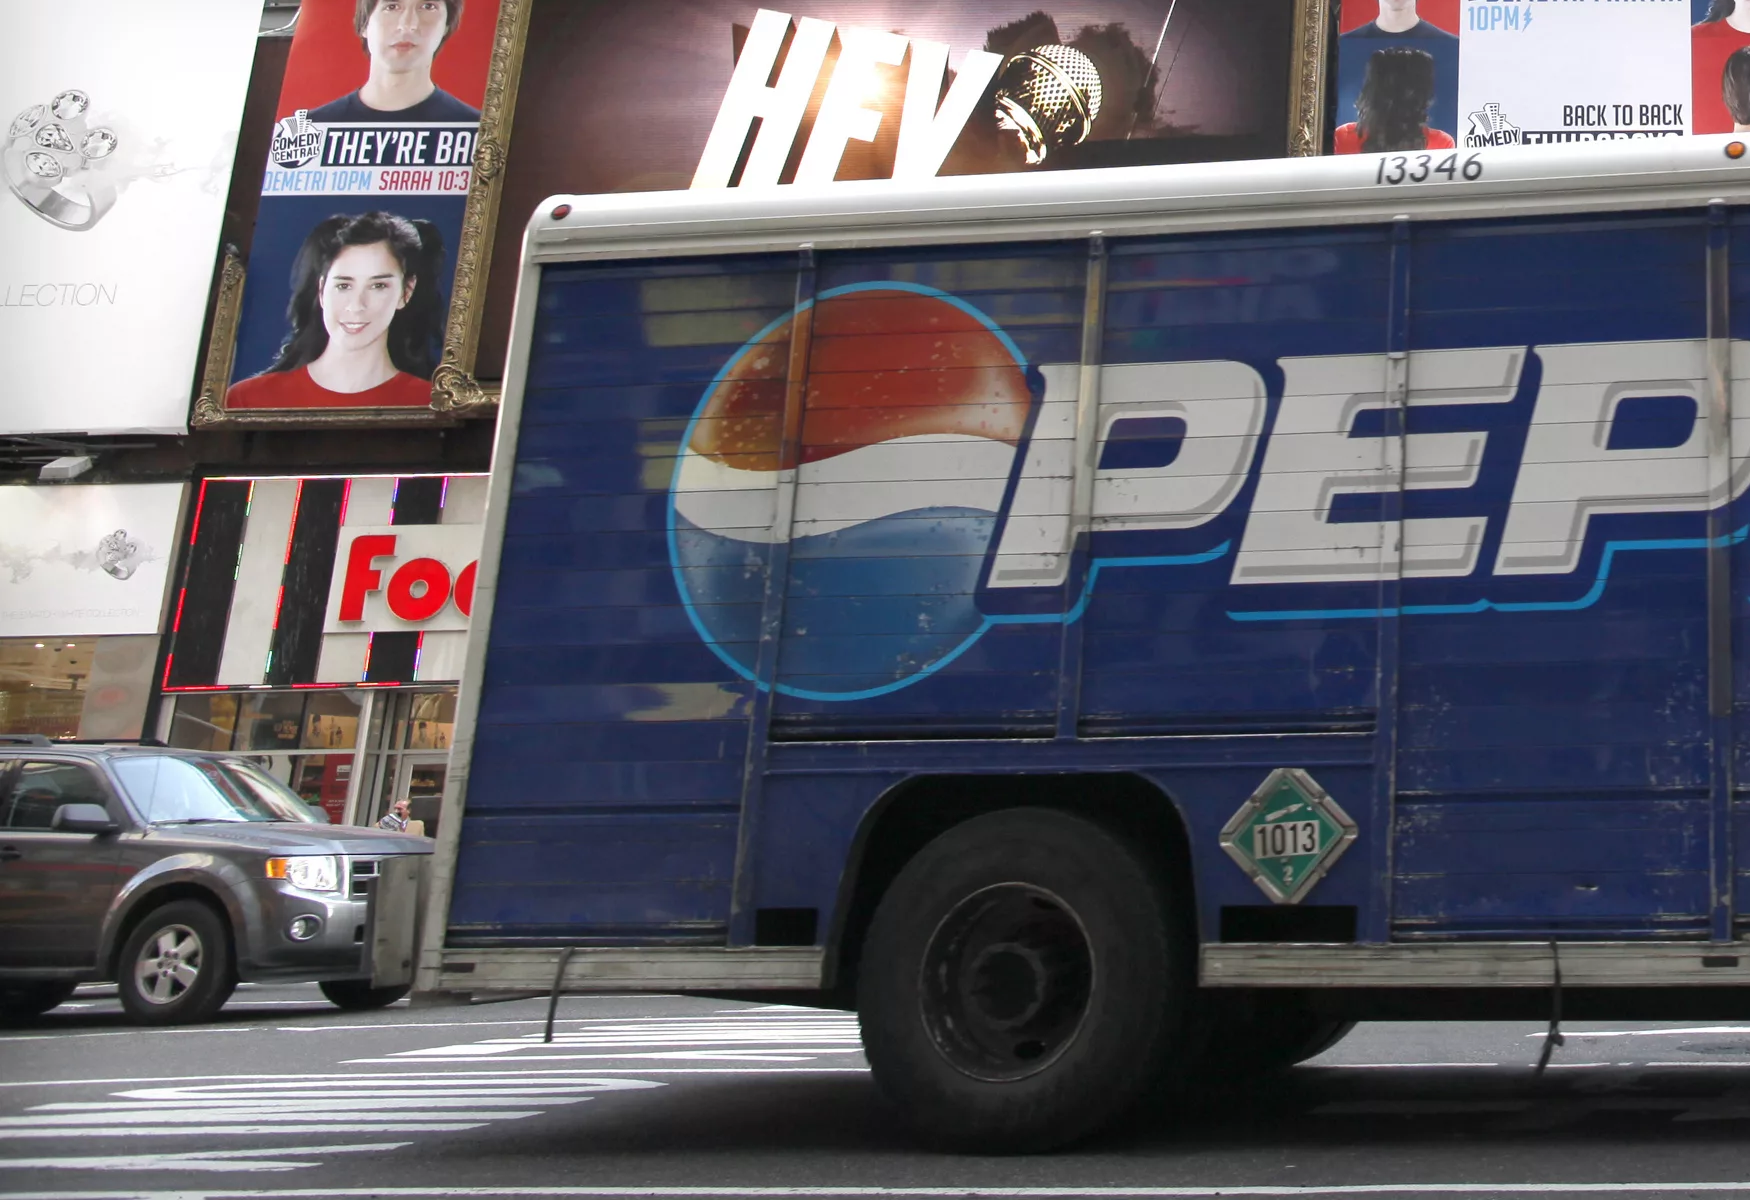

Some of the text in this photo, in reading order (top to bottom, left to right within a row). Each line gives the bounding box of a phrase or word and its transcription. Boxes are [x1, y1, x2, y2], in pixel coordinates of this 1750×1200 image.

[1468, 5, 1520, 31] 10PM
[1563, 104, 1684, 127] BACK TO BACK
[272, 132, 321, 152] COMEDY
[327, 131, 430, 164] THEY'RE
[1466, 129, 1518, 148] COMEDY
[274, 145, 318, 162] CENTRAL
[262, 170, 327, 191] DEMETRI
[331, 171, 373, 191] 10PM
[378, 170, 433, 191] SARAH
[1376, 153, 1484, 185] 13346
[0, 283, 118, 307] LECTION
[1256, 822, 1316, 857] 1013
[1283, 865, 1294, 882] 2
